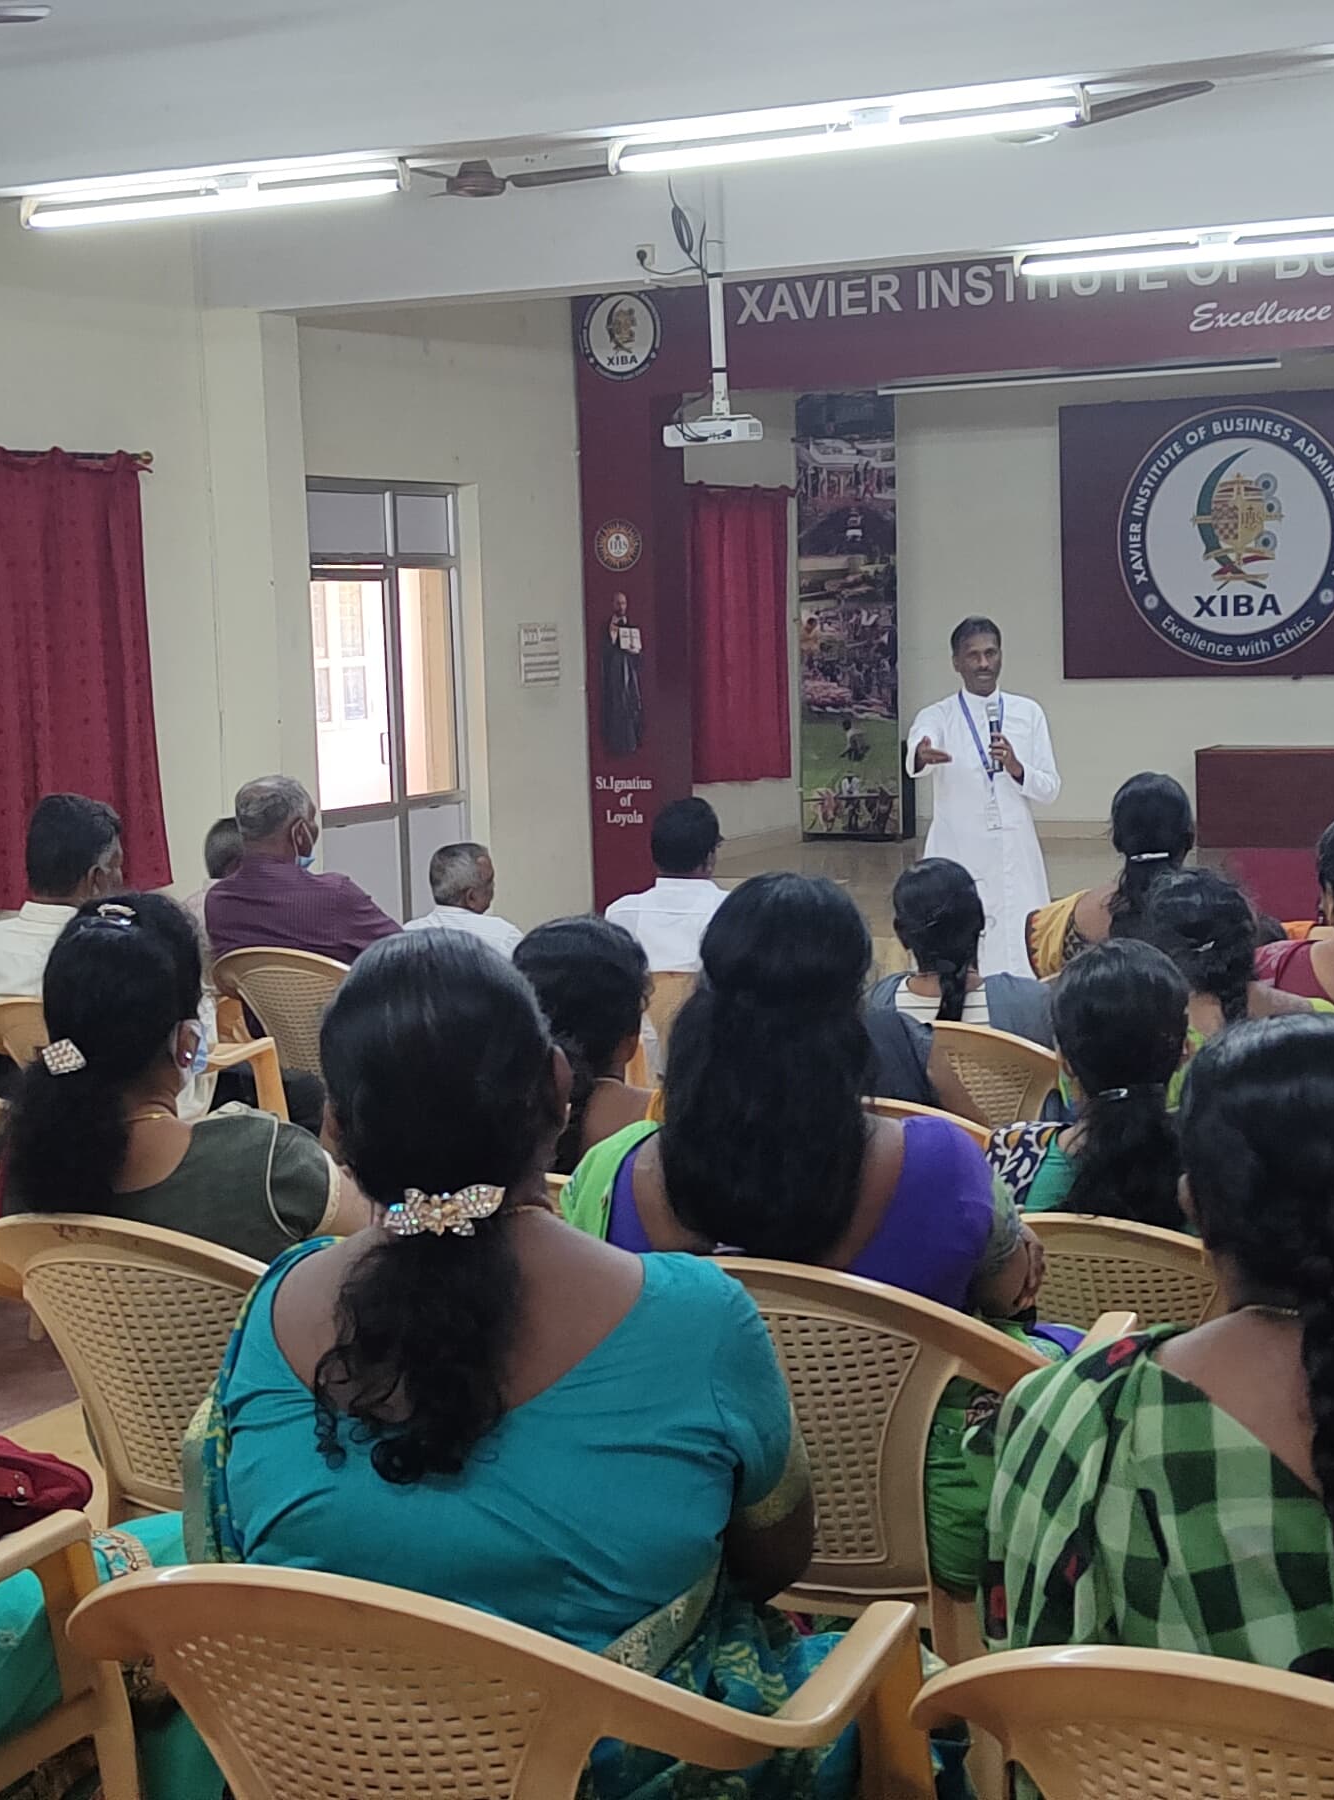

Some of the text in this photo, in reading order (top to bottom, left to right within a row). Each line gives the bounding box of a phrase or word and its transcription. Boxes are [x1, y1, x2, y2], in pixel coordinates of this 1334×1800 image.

[736, 273, 903, 326] XAVIER
[1189, 301, 1332, 332] Excellence
[606, 354, 639, 367] XIBA
[1185, 426, 1208, 446] OF
[1212, 417, 1293, 441] BUSINESS
[1132, 441, 1185, 517] INSTITUTE
[1129, 523, 1149, 585] XAVIER
[1192, 593, 1283, 618] XIBA
[1161, 615, 1316, 657] Excellence with Ethics
[619, 792, 634, 808] of
[606, 809, 644, 828] Loyola
